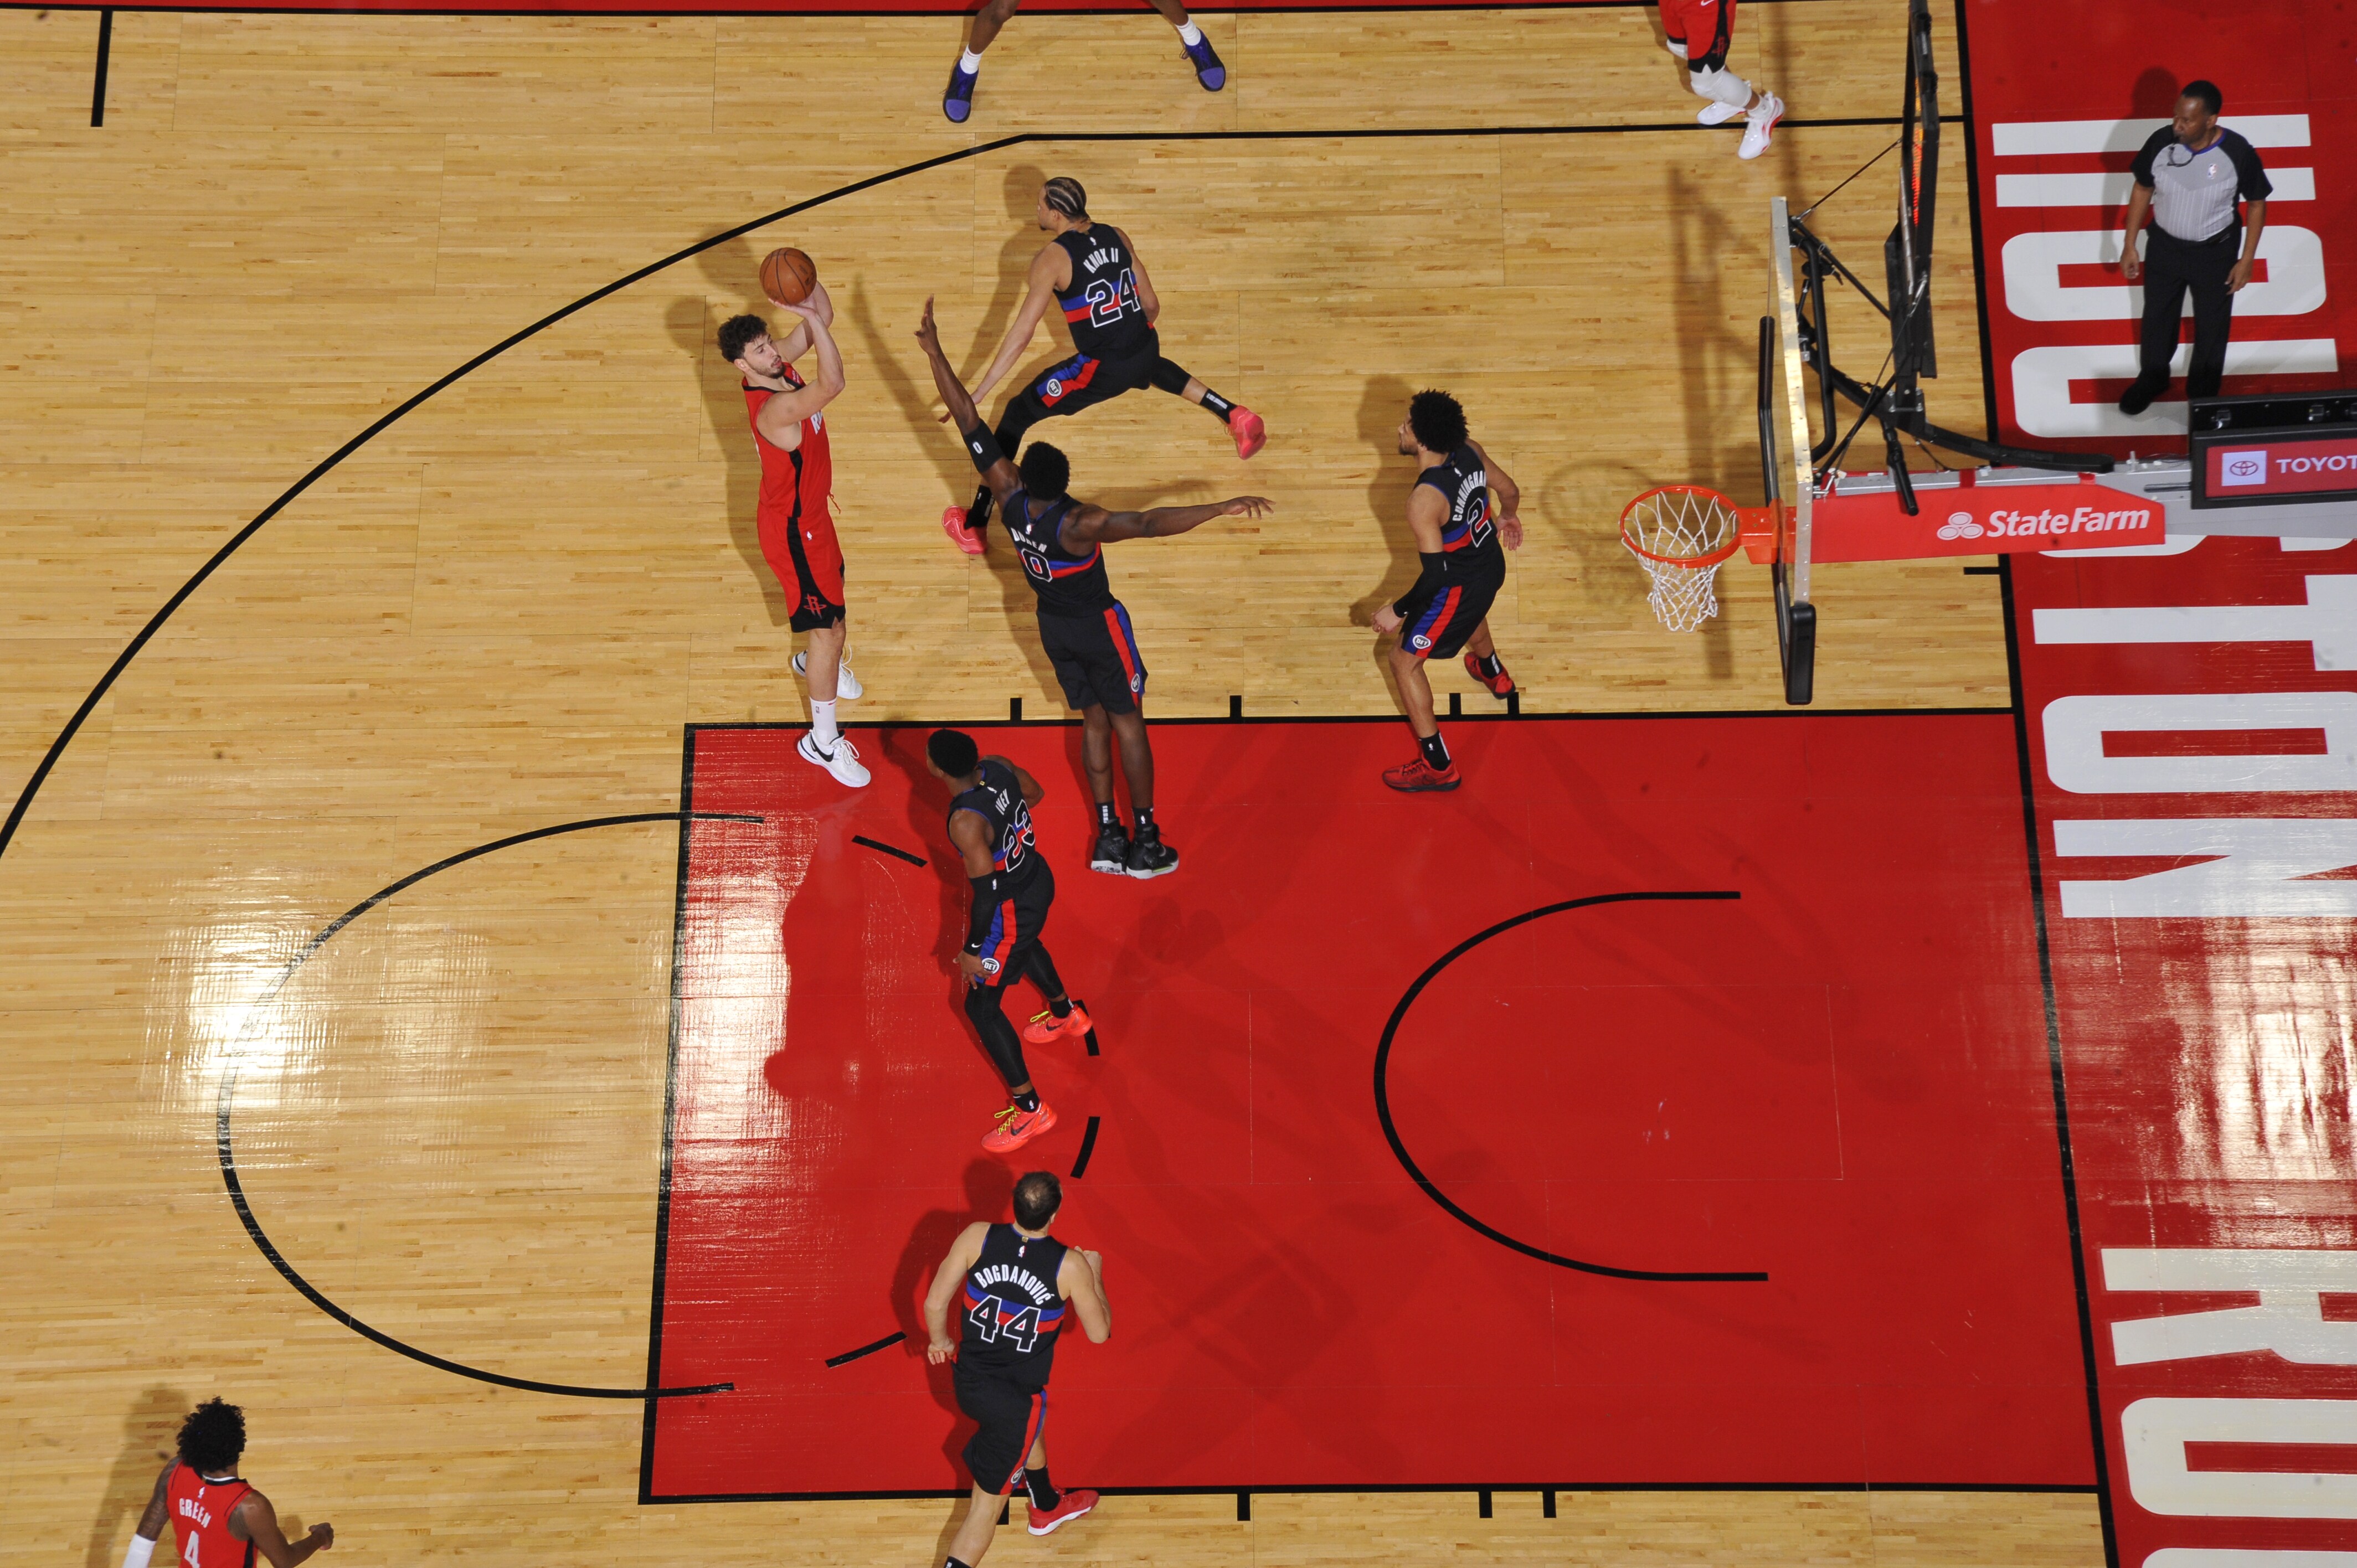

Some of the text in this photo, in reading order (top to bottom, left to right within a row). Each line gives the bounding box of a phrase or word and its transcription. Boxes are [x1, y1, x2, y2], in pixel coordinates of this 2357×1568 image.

[1083, 247, 1119, 274] KNOX II
[1085, 268, 1141, 328] 24
[972, 441, 983, 454] 0
[1466, 497, 1492, 548] 2
[1992, 114, 2357, 918] HOUTON
[1021, 548, 1053, 582] 0
[995, 788, 1010, 815] IVEY
[1003, 798, 1036, 873] 23
[984, 962, 997, 970] DET
[974, 1264, 1054, 1305] BOGDANOVIĆ
[970, 1294, 1041, 1353] 44
[2101, 1247, 2357, 1568] RO
[179, 1498, 212, 1528] GREEN
[184, 1530, 200, 1568] 4
